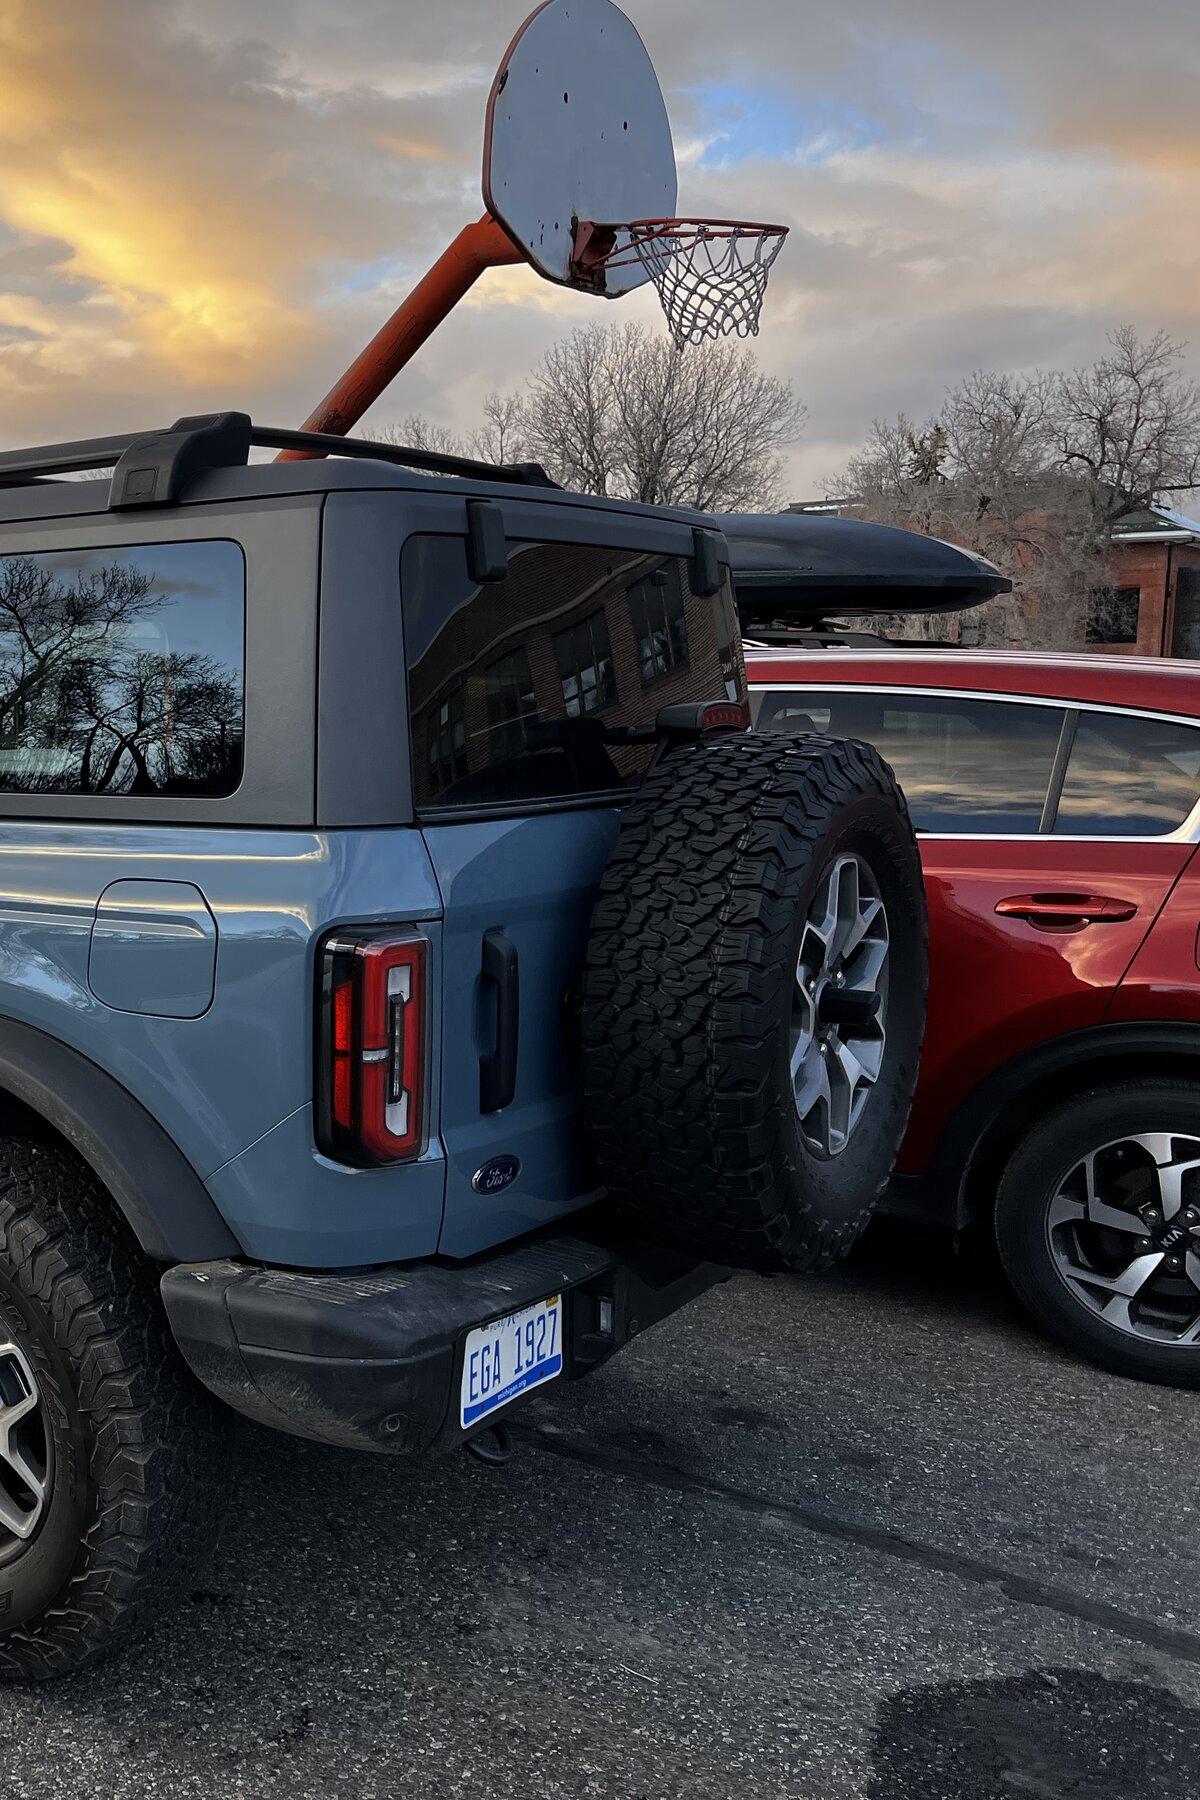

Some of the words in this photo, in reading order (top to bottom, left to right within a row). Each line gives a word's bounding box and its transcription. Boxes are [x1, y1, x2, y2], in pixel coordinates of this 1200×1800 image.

[486, 1167, 513, 1188] Ford
[1161, 1230, 1183, 1247] KIA
[469, 1339, 501, 1402] EGA
[514, 1308, 557, 1374] 1927
[497, 1379, 527, 1400] michigan.org
